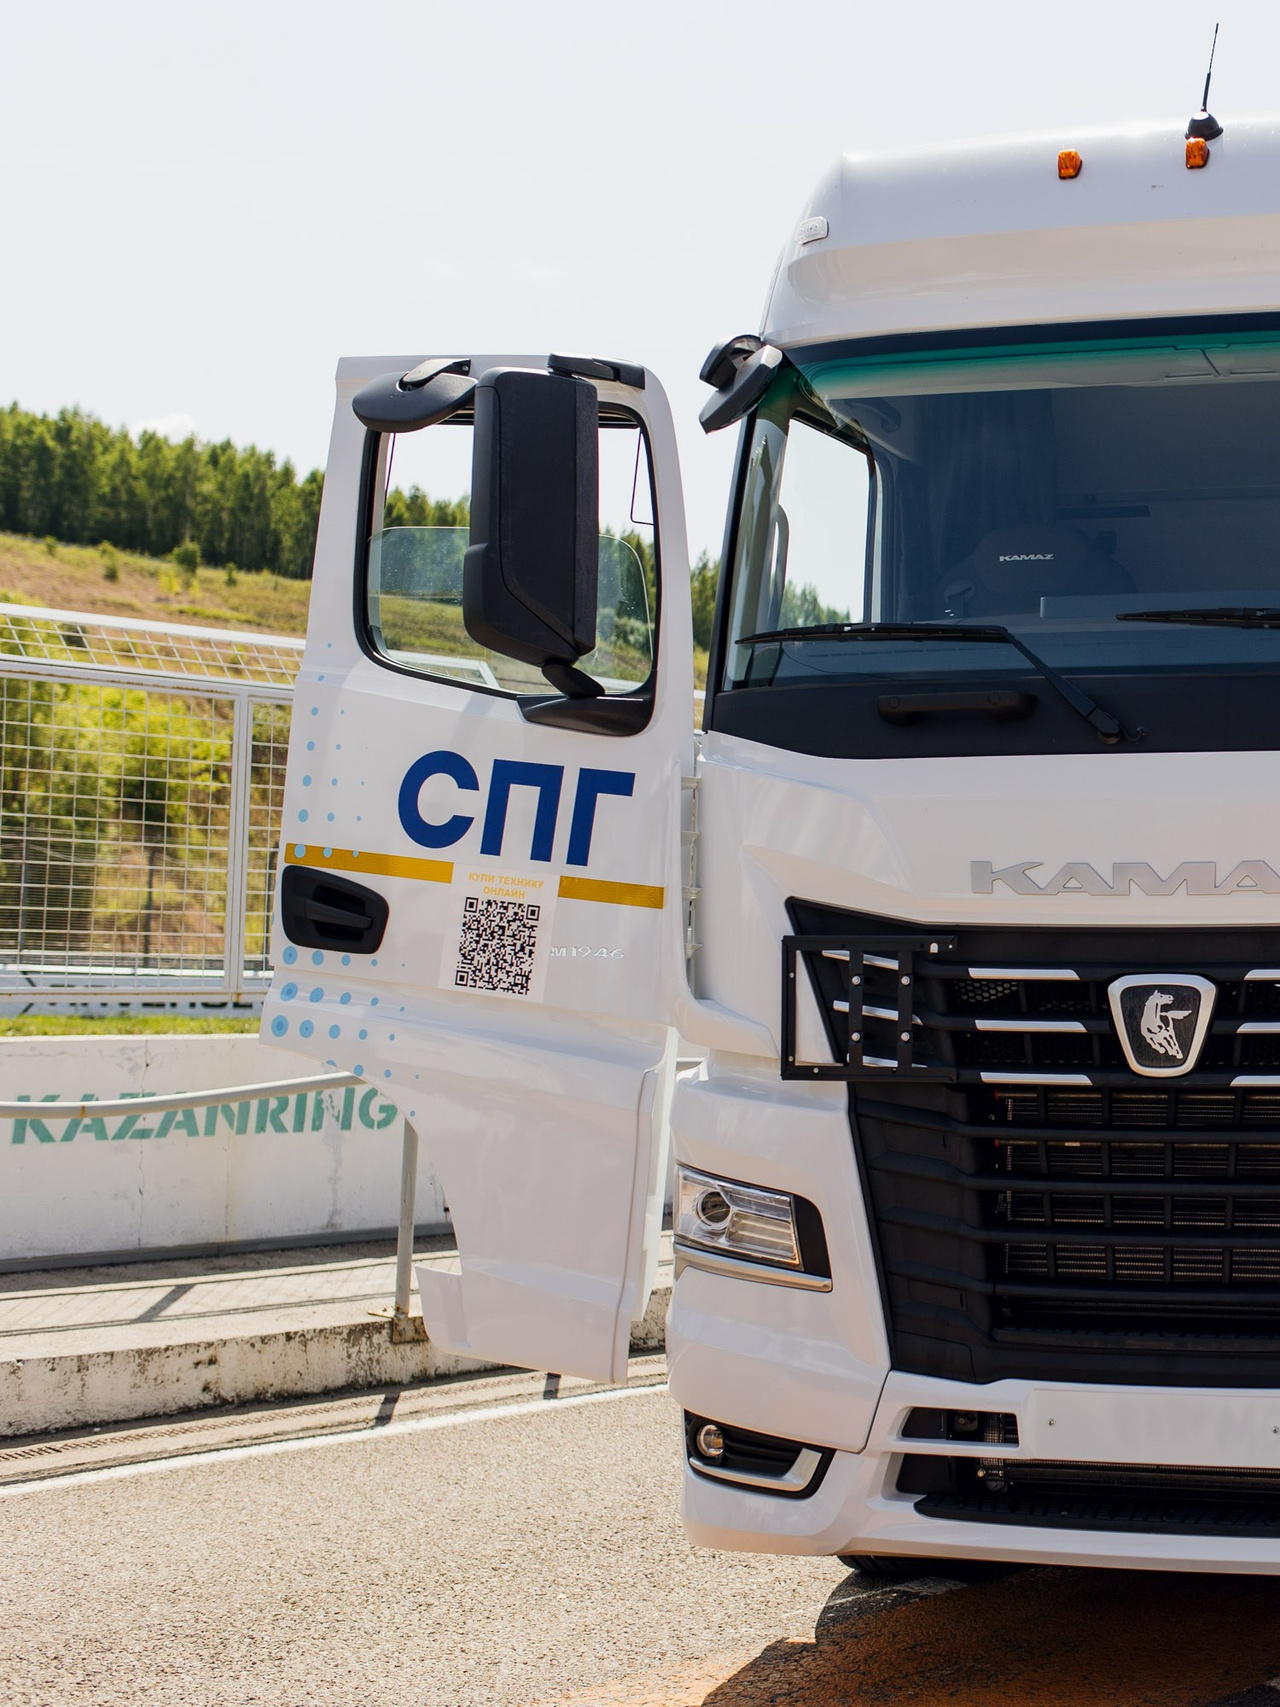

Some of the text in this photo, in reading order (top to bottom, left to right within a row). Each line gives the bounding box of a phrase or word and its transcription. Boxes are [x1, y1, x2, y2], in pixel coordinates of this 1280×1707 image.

[999, 554, 1054, 562] KAMAZ
[398, 750, 636, 867] СПГ
[468, 871, 544, 889] КУПИ ТЕХНИКУ
[483, 885, 526, 899] ОНЛАЙН
[11, 1086, 399, 1145] KAZANRING
